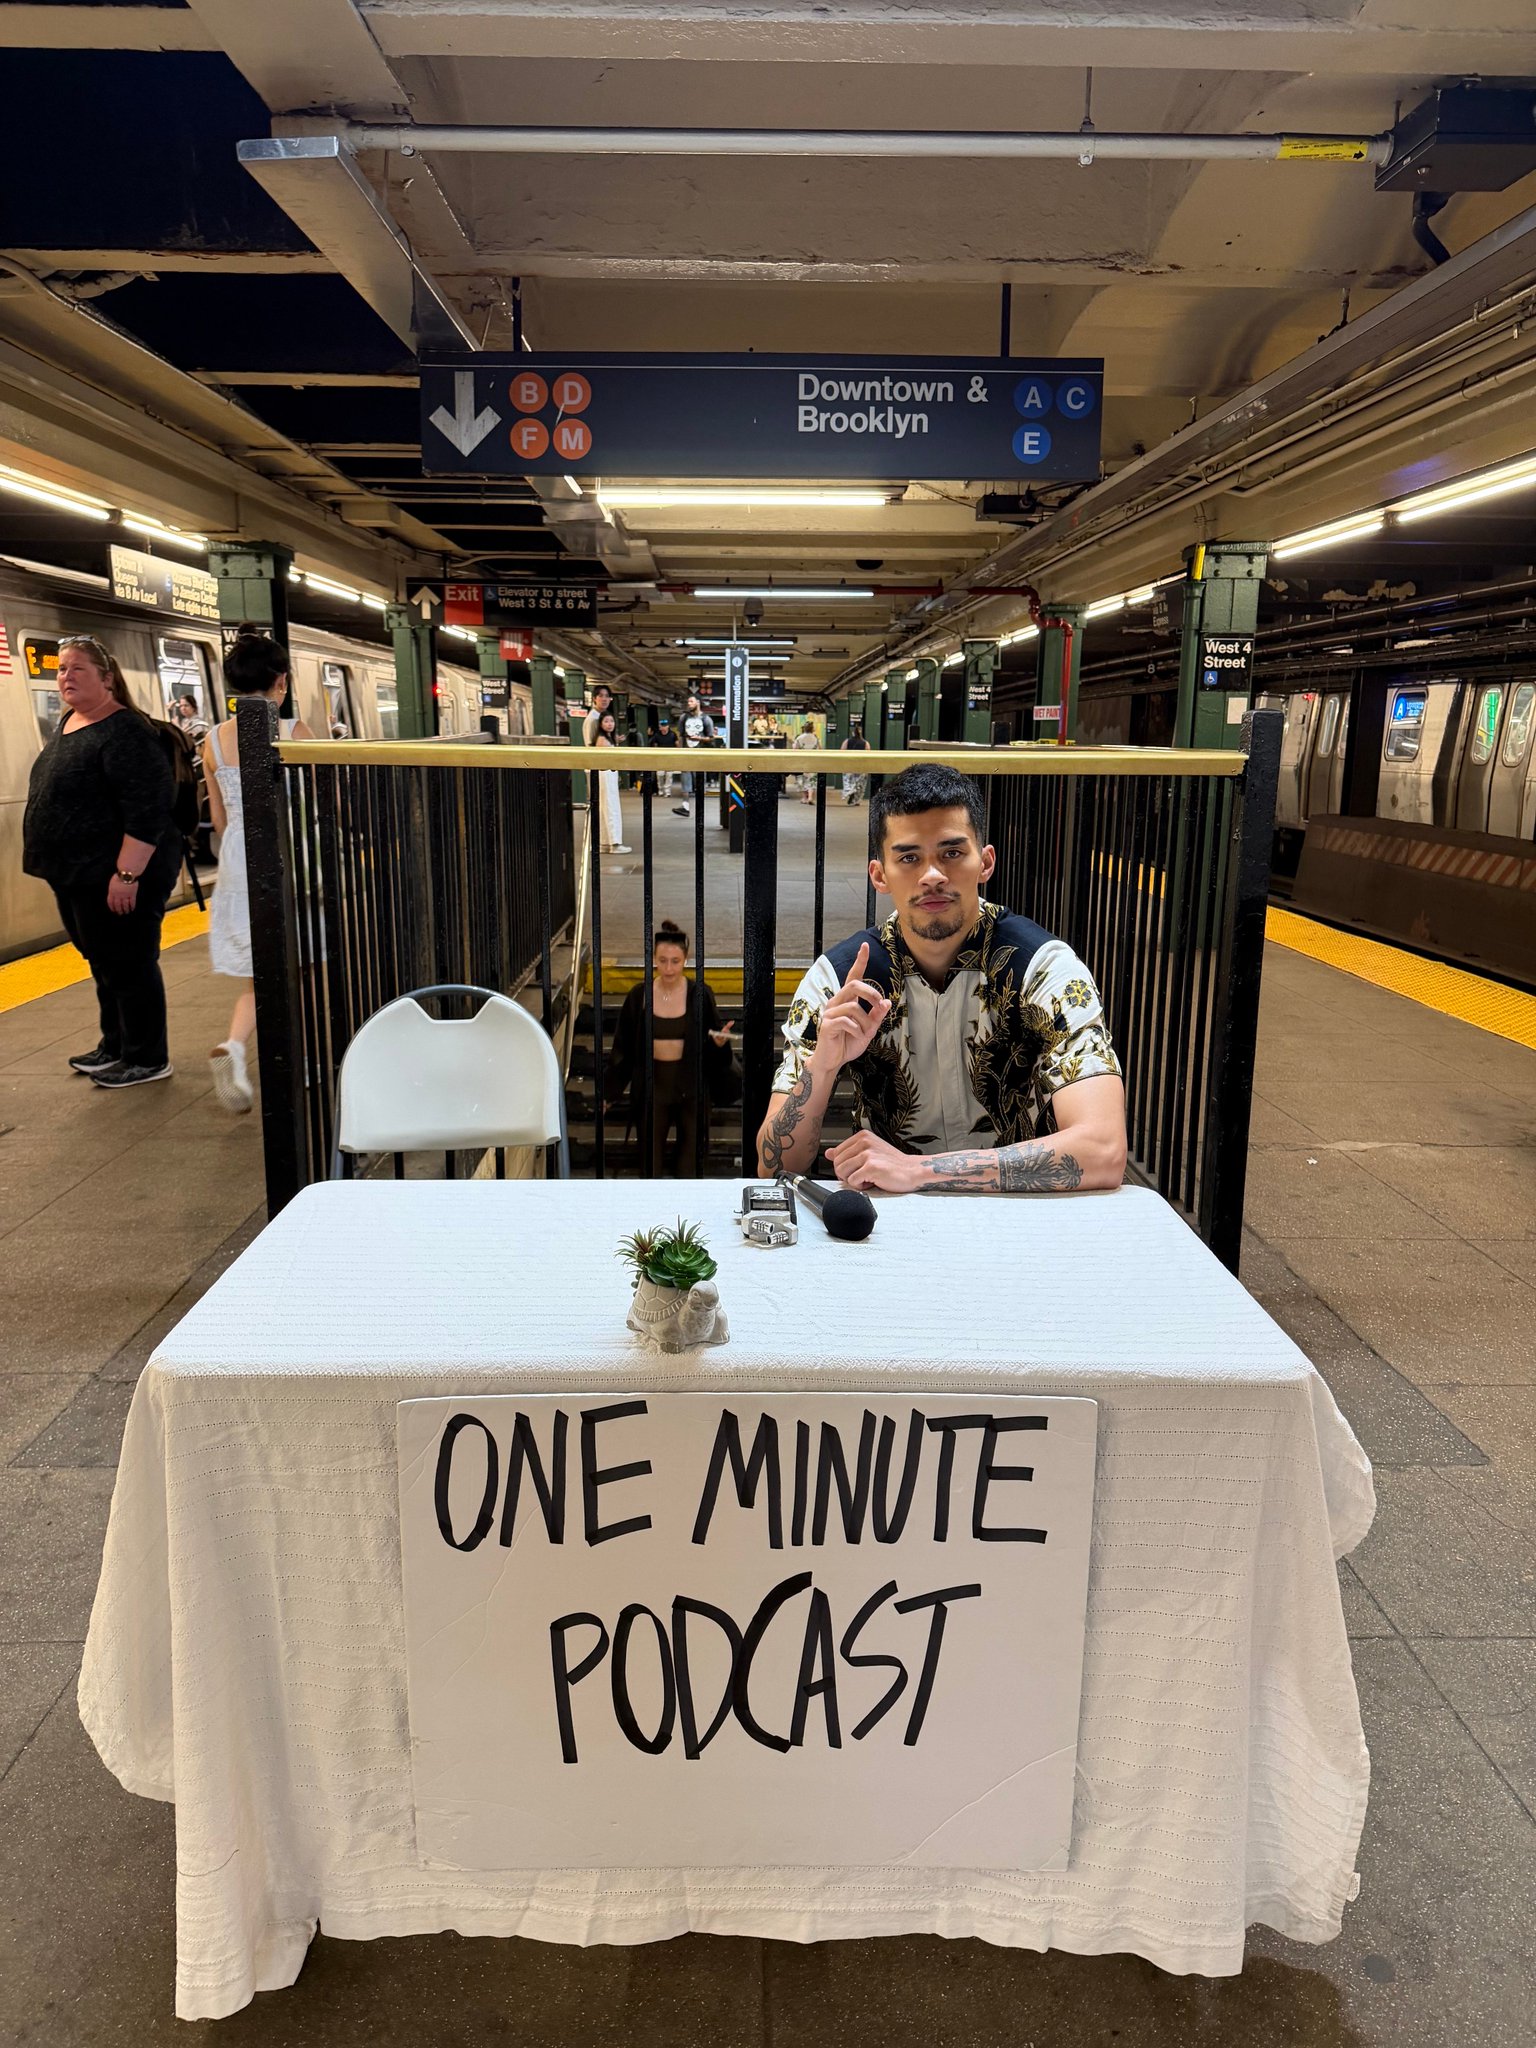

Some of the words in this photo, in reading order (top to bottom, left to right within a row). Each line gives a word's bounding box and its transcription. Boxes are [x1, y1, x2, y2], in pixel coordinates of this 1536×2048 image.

[520, 381, 539, 404] B
[563, 381, 583, 405] D
[798, 373, 954, 402] Downtown
[966, 375, 989, 403] &
[1024, 386, 1043, 409] A
[1066, 386, 1086, 410] C
[798, 405, 929, 439] Brooklyn
[521, 427, 539, 450] F
[561, 427, 584, 450] M
[1023, 432, 1041, 455] E
[125, 585, 131, 599] 8
[140, 589, 158, 604] Local
[445, 586, 480, 602] Exit
[498, 587, 538, 597] Elevator
[542, 588, 553, 598] to
[557, 588, 588, 598] street
[499, 599, 525, 608] West
[528, 599, 537, 608] 3
[539, 599, 552, 609] St
[554, 599, 563, 609] &
[566, 600, 575, 610] 6
[578, 600, 591, 610] Av
[1205, 641, 1240, 654] West
[1242, 641, 1252, 654] 4
[26, 646, 41, 674] E
[1147, 664, 1156, 674] 8
[1203, 655, 1247, 669] Street
[732, 675, 742, 721] Information
[1396, 702, 1404, 717] A
[435, 1400, 653, 1553] ONE
[691, 1408, 1048, 1550] MINUTE
[550, 1571, 983, 1765] PODCAST
